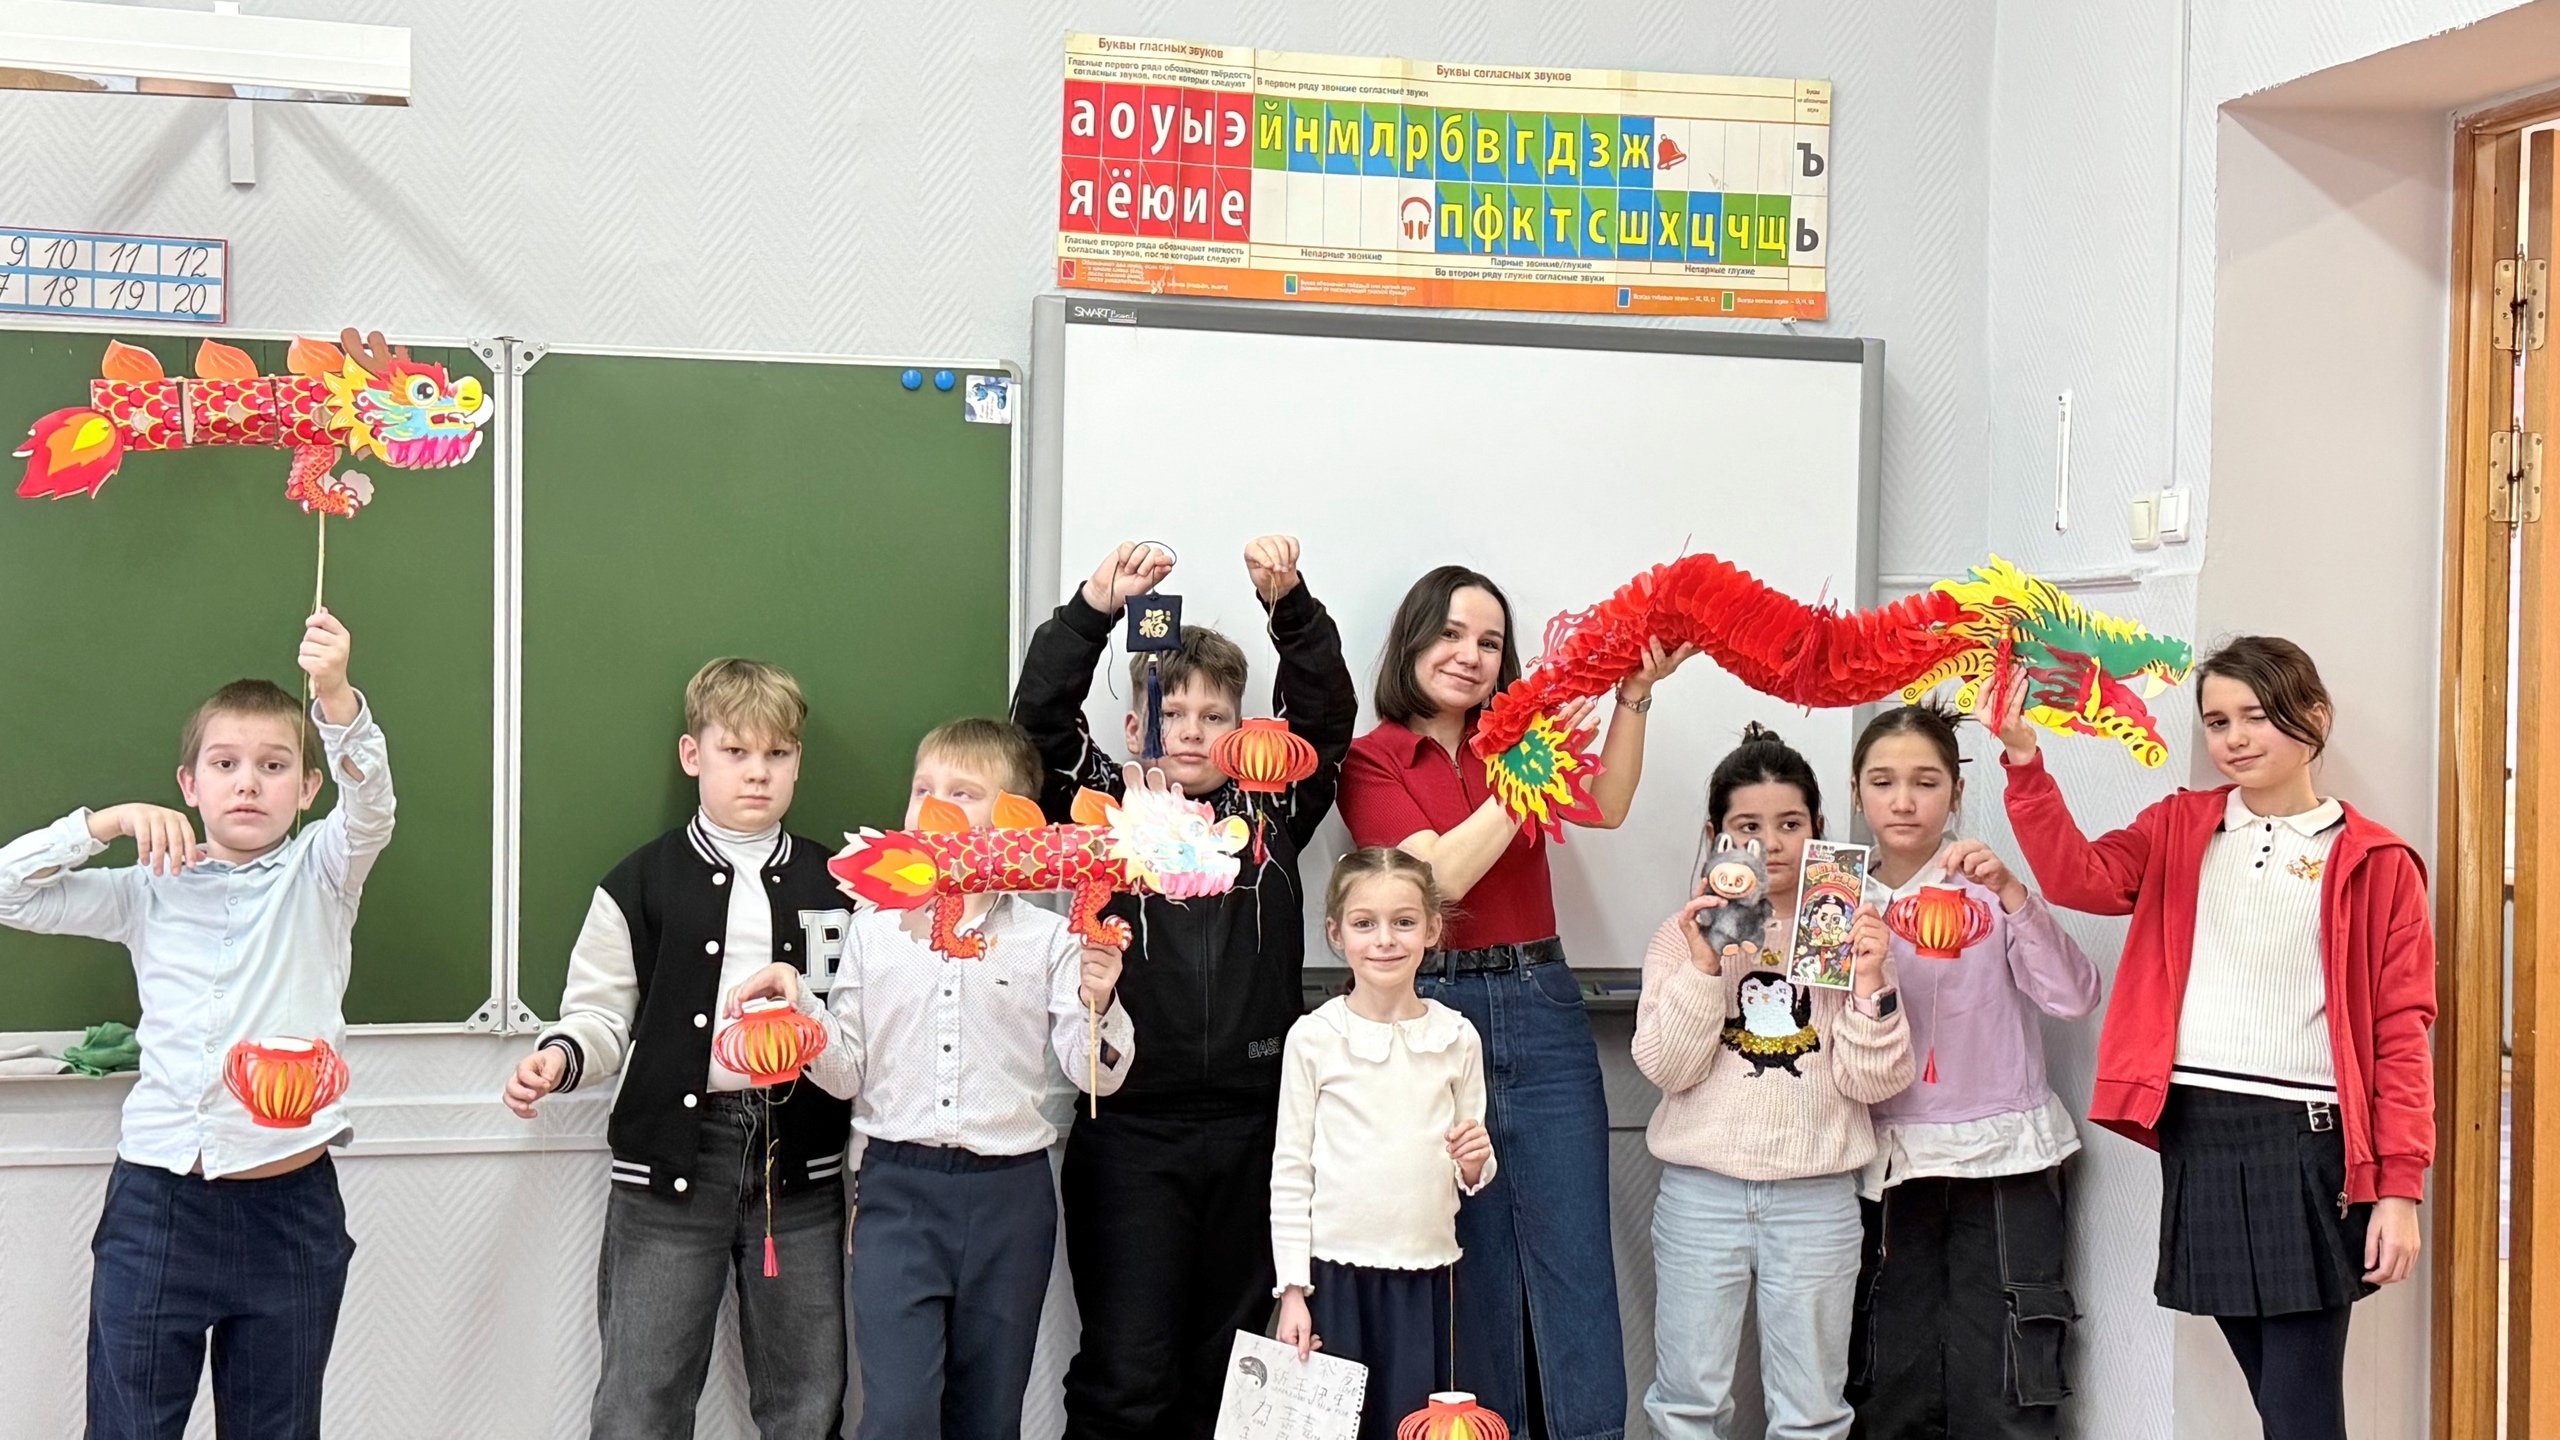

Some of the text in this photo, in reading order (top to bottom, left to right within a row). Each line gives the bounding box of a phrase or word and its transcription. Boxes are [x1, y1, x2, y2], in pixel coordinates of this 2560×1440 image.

[1098, 37, 1224, 59] Буквы гласных звуков
[1068, 57, 1103, 68] Гласные
[1105, 59, 1138, 71] первого
[1141, 62, 1162, 72] ряда
[1436, 64, 1572, 83] Буквы согласных звуков
[1073, 68, 1117, 77] согласных
[1152, 74, 1177, 82] после
[1179, 76, 1210, 86] которых
[1211, 79, 1246, 88] следуют
[1257, 77, 1429, 98] В первом ряду звонкие согласные звуки
[1070, 99, 1247, 156] а о у ы э
[1260, 100, 1650, 176] й н м л р б в г д з ж
[1796, 142, 1825, 177] ъ
[1067, 167, 1245, 227] я ё ю и е
[1440, 192, 1787, 260] п ф к т с ш х ц ч щ
[1796, 217, 1820, 252] ь
[1064, 235, 1245, 255] Гласные второго ряда обозначают мягкость
[1067, 246, 1110, 255] согласных
[1171, 253, 1205, 262] которых
[1206, 255, 1241, 264] следуют
[1301, 248, 1383, 261] Непарные звонкие
[6, 235, 209, 278] 9 10 11 12
[1491, 257, 1593, 270] Парные звонкие/глухие
[1435, 268, 1605, 284] Во втором ряду глухие согласные звуки
[1684, 264, 1756, 277] Непарные глухие
[0, 274, 207, 315] 7 18 19 20
[1074, 306, 1111, 318] SMART
[1139, 608, 1169, 638] 福
